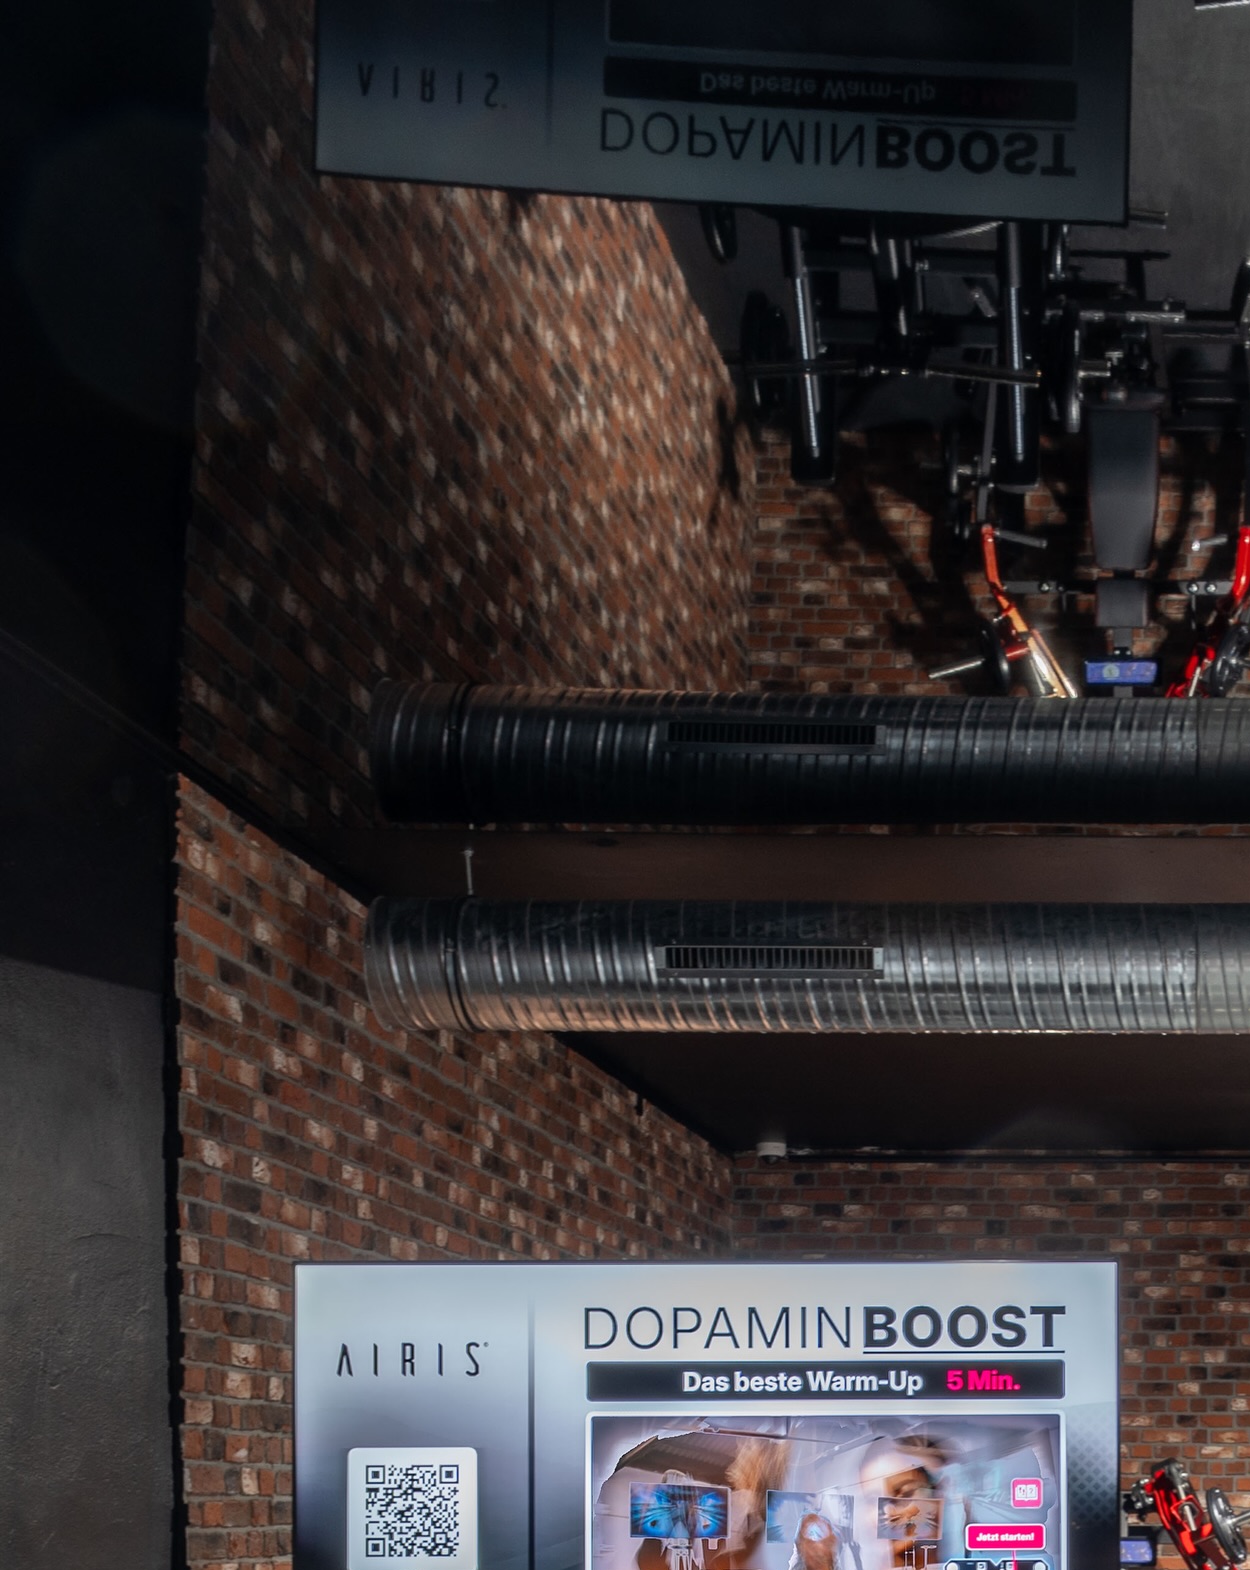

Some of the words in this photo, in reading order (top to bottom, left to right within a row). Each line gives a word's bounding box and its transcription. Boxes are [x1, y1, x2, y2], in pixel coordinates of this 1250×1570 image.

[682, 1371, 730, 1393] Das
[733, 1371, 802, 1393] beste
[807, 1369, 923, 1396] Warm-Up
[946, 1370, 964, 1391] 5
[967, 1369, 1022, 1391] Min.
[976, 1532, 999, 1542] Jetzt
[1000, 1532, 1035, 1541] starten!
